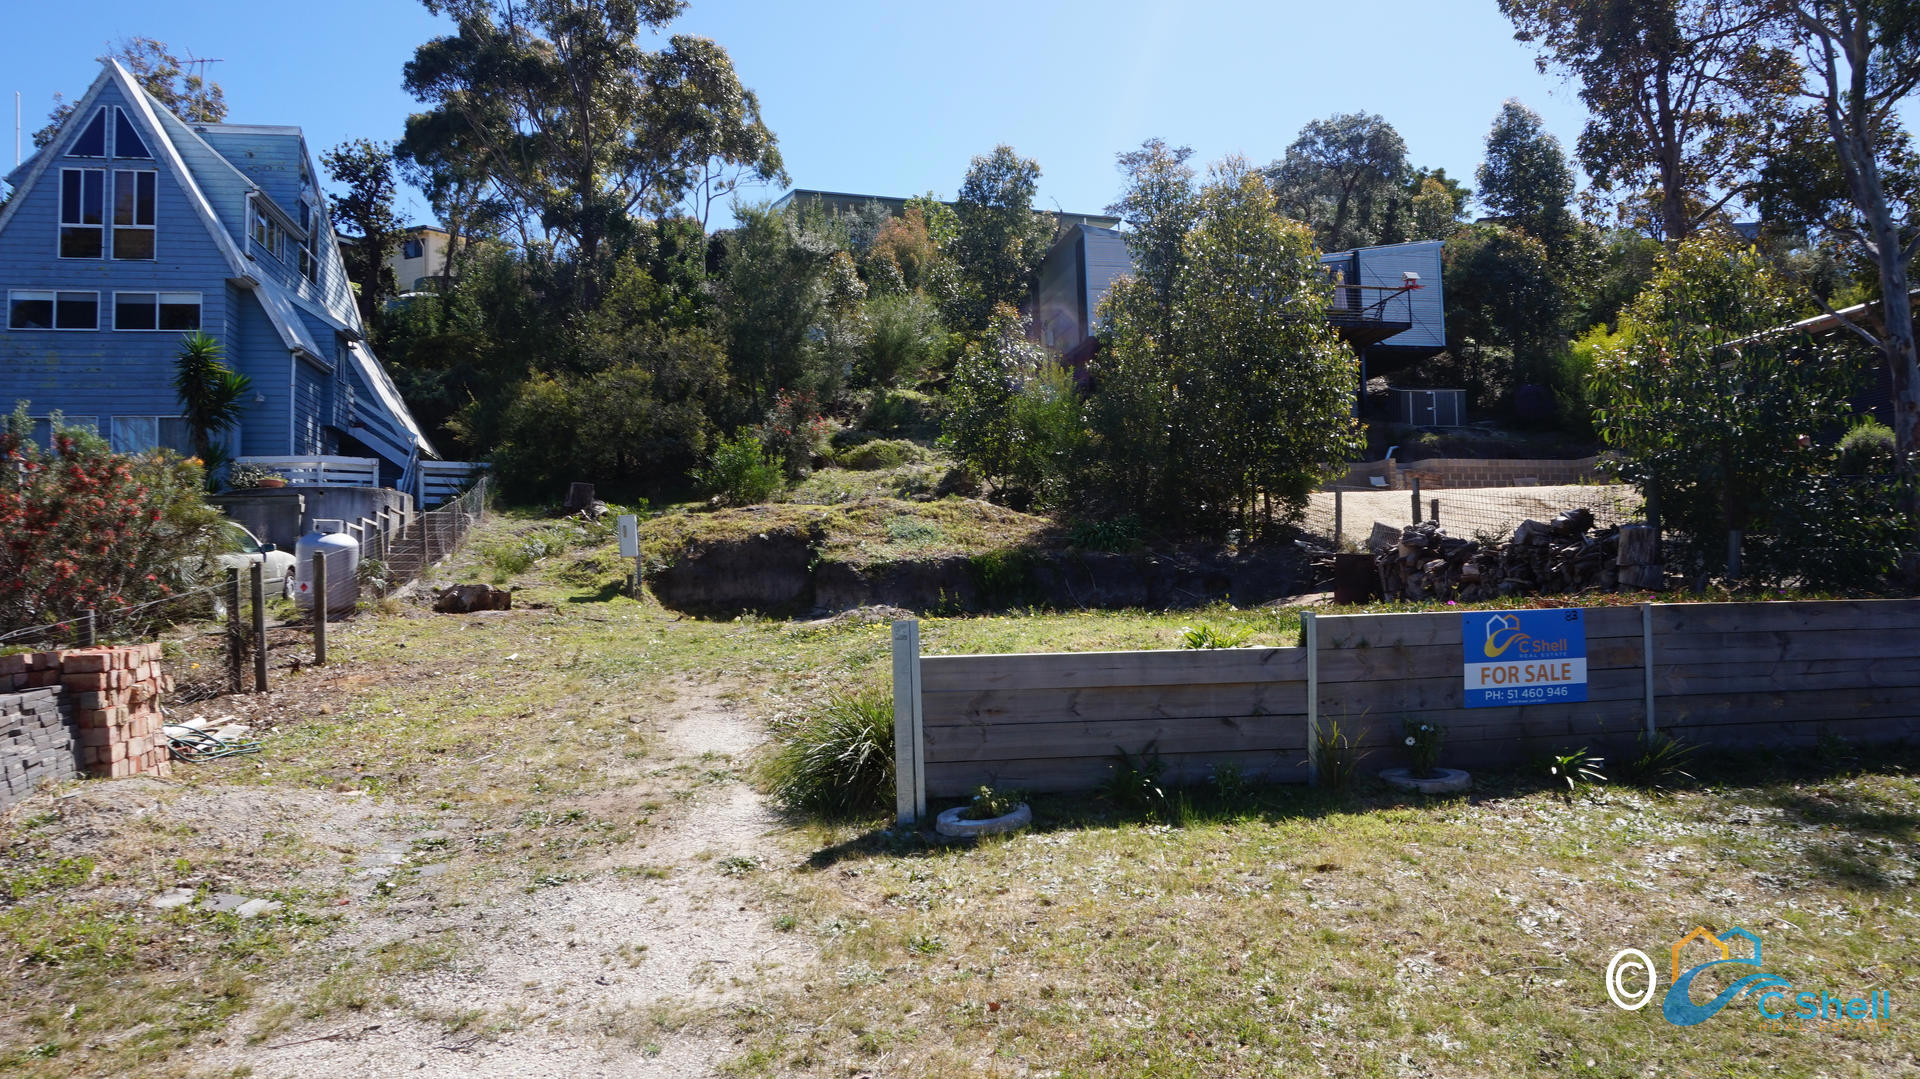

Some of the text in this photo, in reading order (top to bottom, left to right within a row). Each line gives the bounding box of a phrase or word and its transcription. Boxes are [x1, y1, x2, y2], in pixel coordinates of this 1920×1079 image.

[1519, 638, 1567, 653] C Shell
[1481, 663, 1571, 685] FOR SALE
[1485, 686, 1568, 700] PH: 51 460 946
